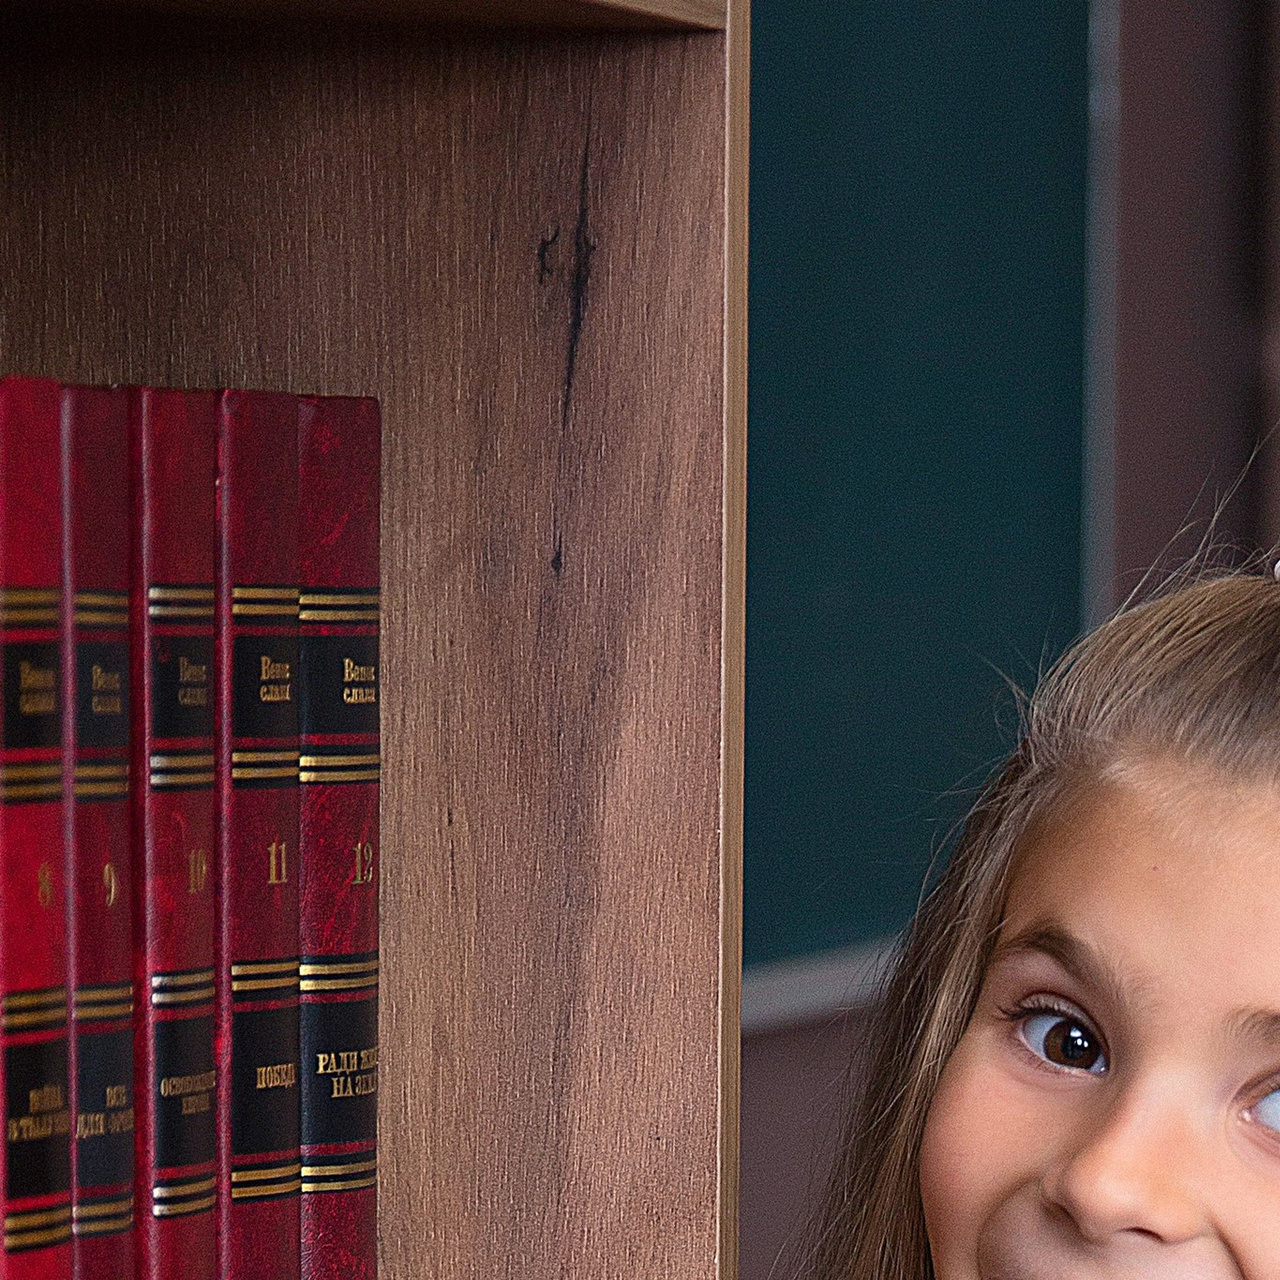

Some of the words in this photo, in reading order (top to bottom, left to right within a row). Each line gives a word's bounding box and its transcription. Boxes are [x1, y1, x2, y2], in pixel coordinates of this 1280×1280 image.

[268, 841, 288, 884] 11
[352, 841, 374, 884] 12
[103, 863, 117, 906] 9
[316, 1051, 358, 1076] РАДИ
[331, 1076, 355, 1098] НА
